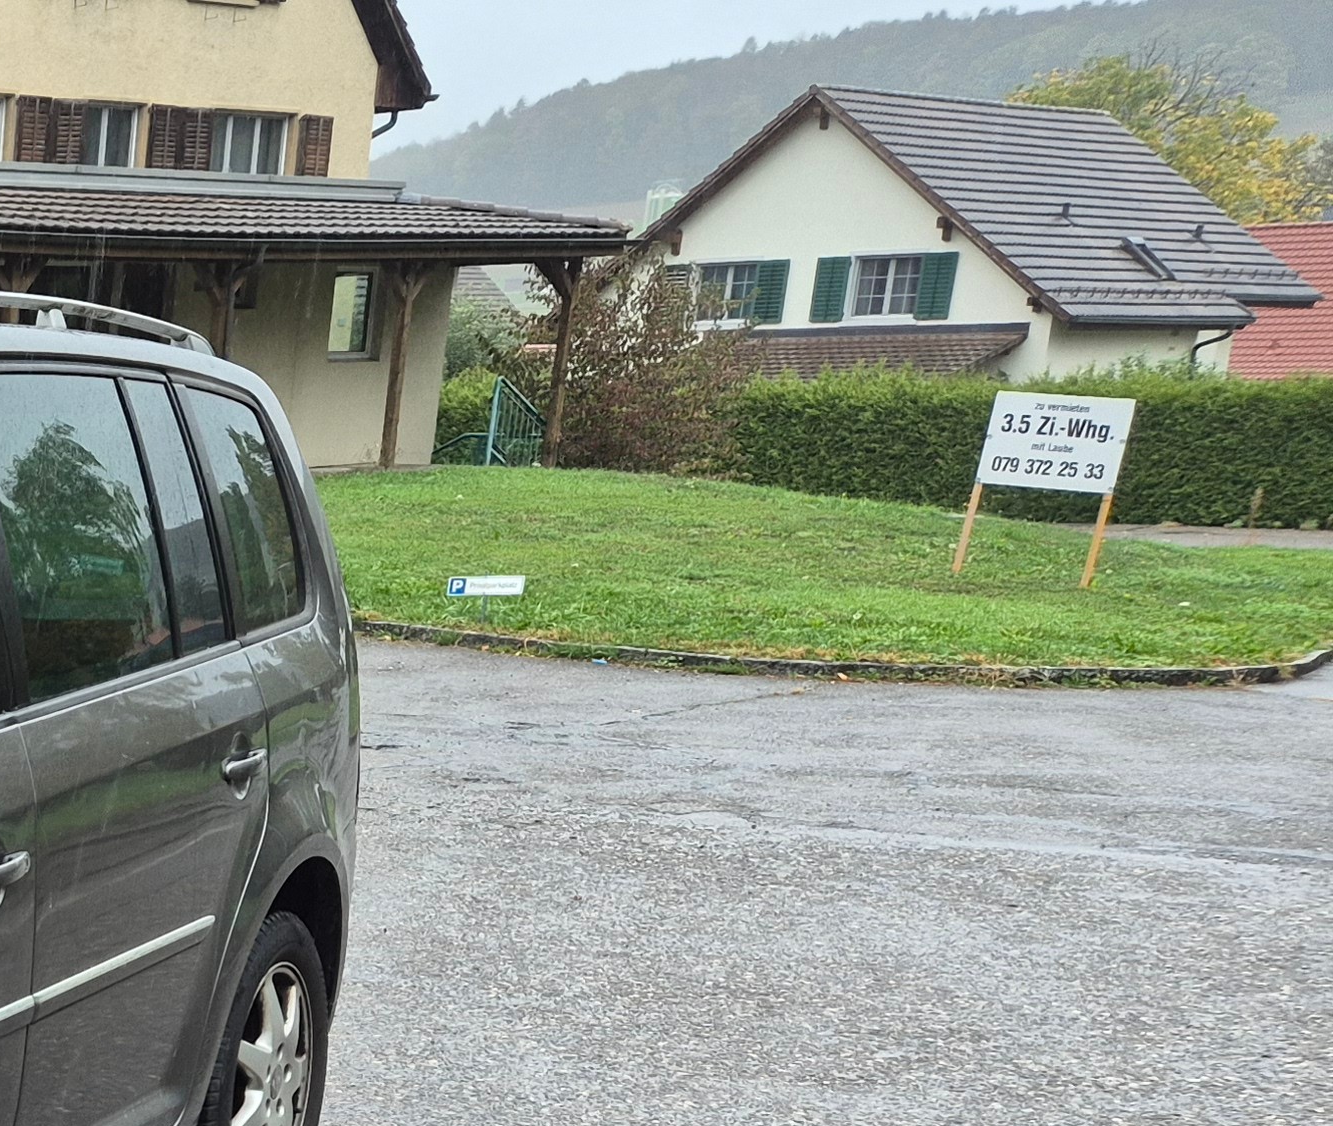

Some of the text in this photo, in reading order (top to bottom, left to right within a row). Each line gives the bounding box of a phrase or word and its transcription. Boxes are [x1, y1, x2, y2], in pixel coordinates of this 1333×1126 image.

[1000, 413, 1115, 443] 3.5 Zi.-Whg.
[991, 455, 1105, 479] 079 372 25 33
[451, 579, 464, 593] P
